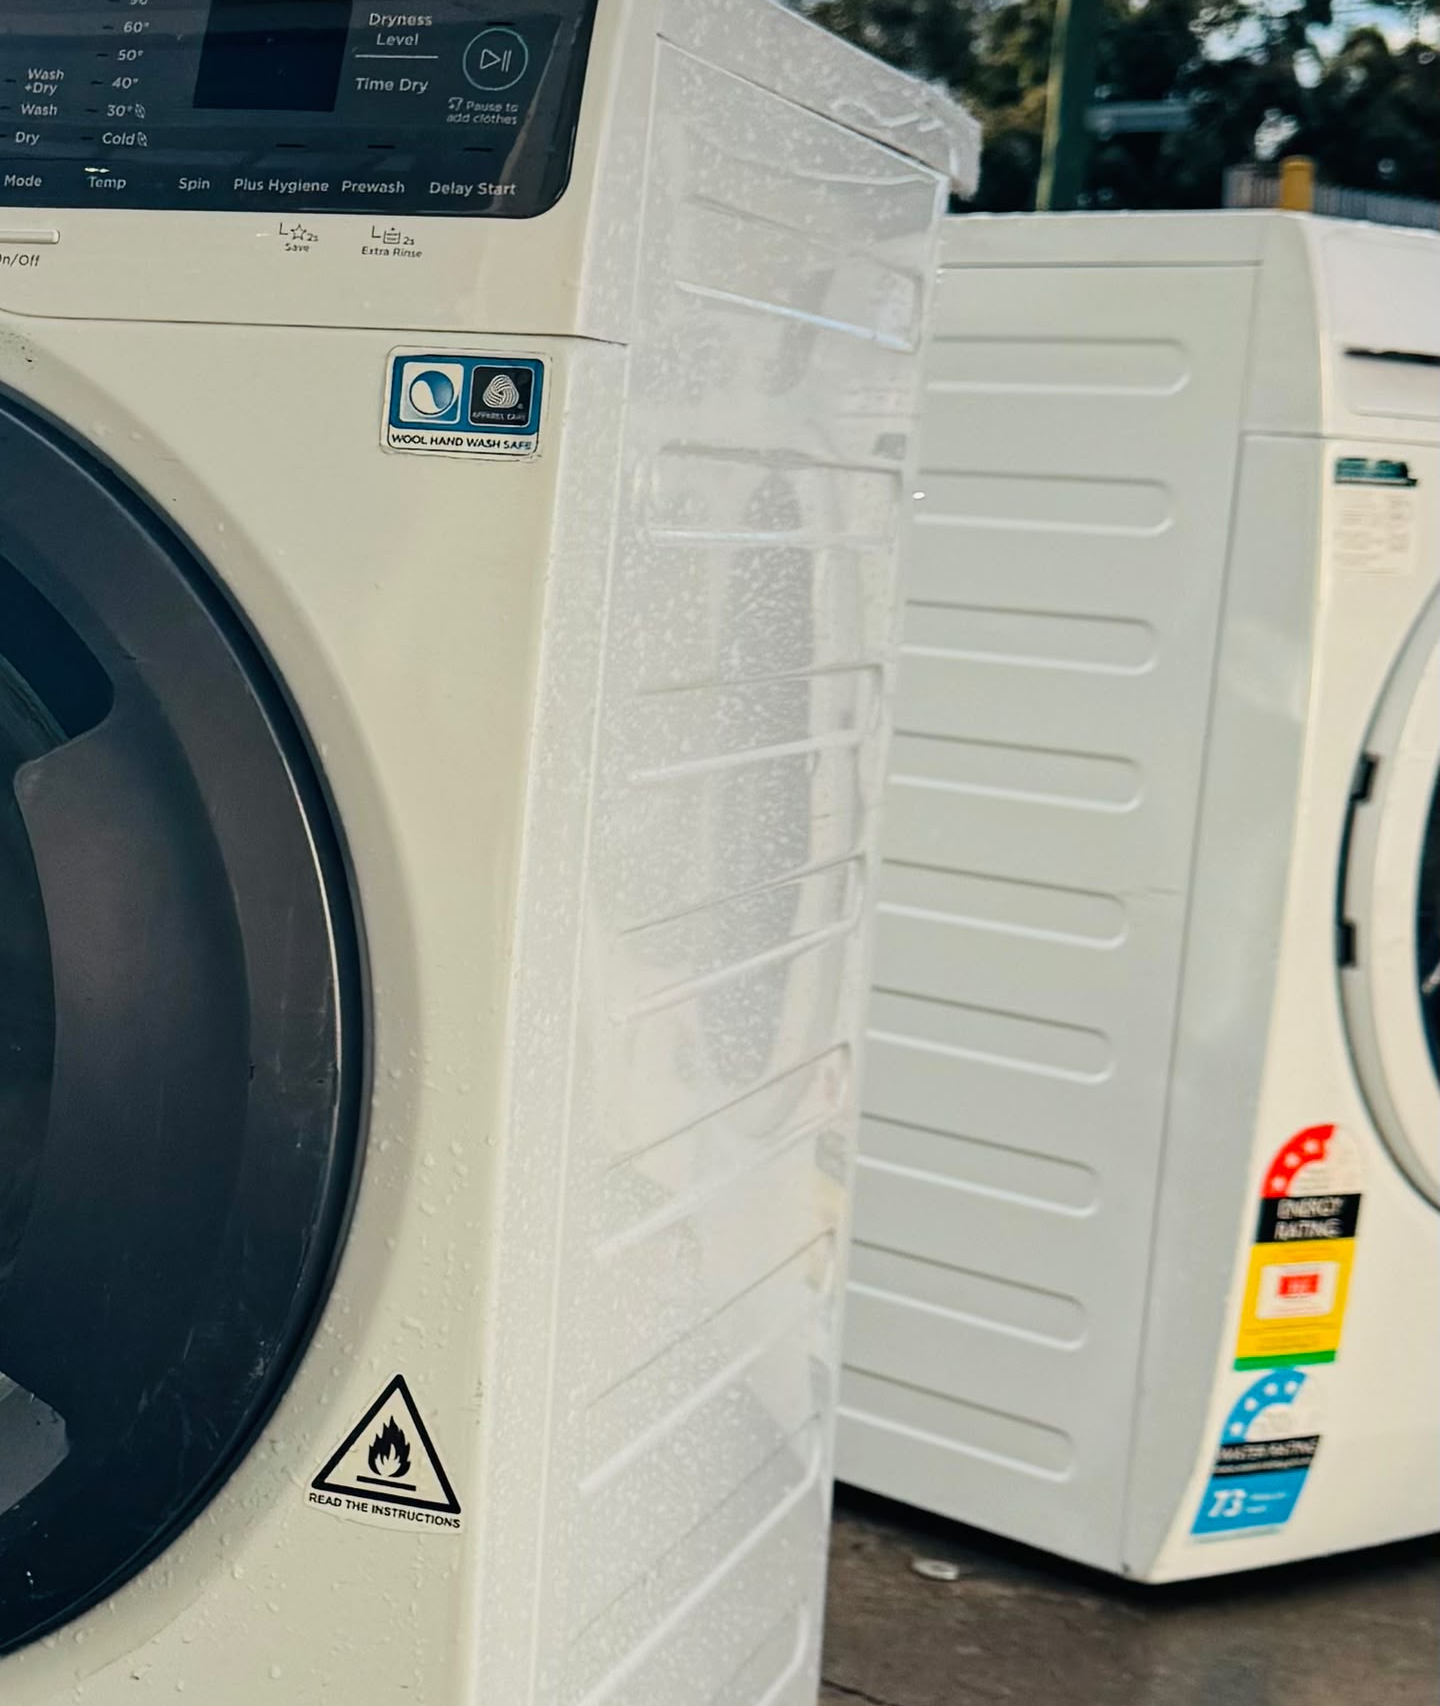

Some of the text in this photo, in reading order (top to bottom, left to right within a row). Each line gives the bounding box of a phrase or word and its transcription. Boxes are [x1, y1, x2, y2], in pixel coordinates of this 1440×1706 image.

[368, 13, 433, 29] Dryness
[376, 33, 419, 46] Level
[27, 68, 64, 81] Wash
[355, 77, 429, 95] Time Dry
[21, 103, 58, 116] Wash
[466, 100, 520, 113] Pause to
[446, 113, 518, 125] add clothes
[15, 131, 40, 145] Dry
[102, 132, 136, 146] Cold
[4, 175, 42, 187] Mode
[89, 176, 127, 191] Temp
[178, 178, 210, 191] Spin
[233, 178, 329, 197] Plus Hygiene
[342, 180, 406, 194] Prewash
[429, 181, 517, 198] Delay Start
[284, 243, 310, 252] Save
[361, 246, 423, 258] Extra Rinse
[391, 433, 532, 451] WOOL HAND WASH SAFE
[308, 1492, 461, 1529] READ THE INSTRUCTIONS
